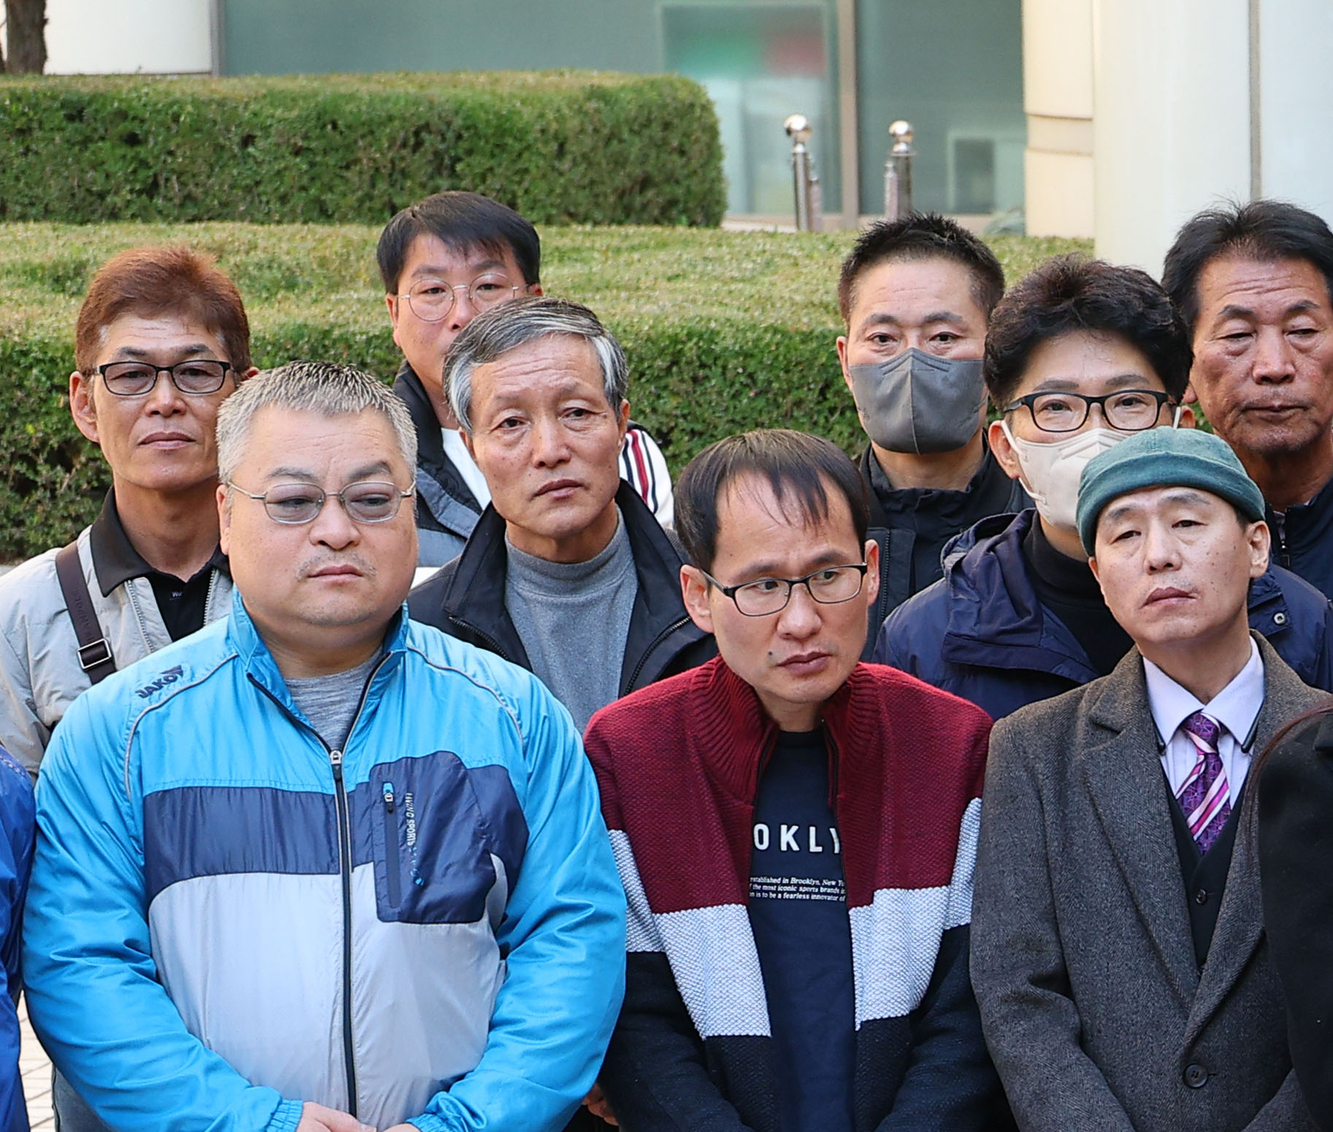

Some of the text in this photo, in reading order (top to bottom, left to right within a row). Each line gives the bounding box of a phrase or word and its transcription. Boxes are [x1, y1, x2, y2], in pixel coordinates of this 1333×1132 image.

[135, 674, 179, 699] JAKO
[405, 792, 415, 819] LIVING
[406, 819, 417, 847] SPORTS
